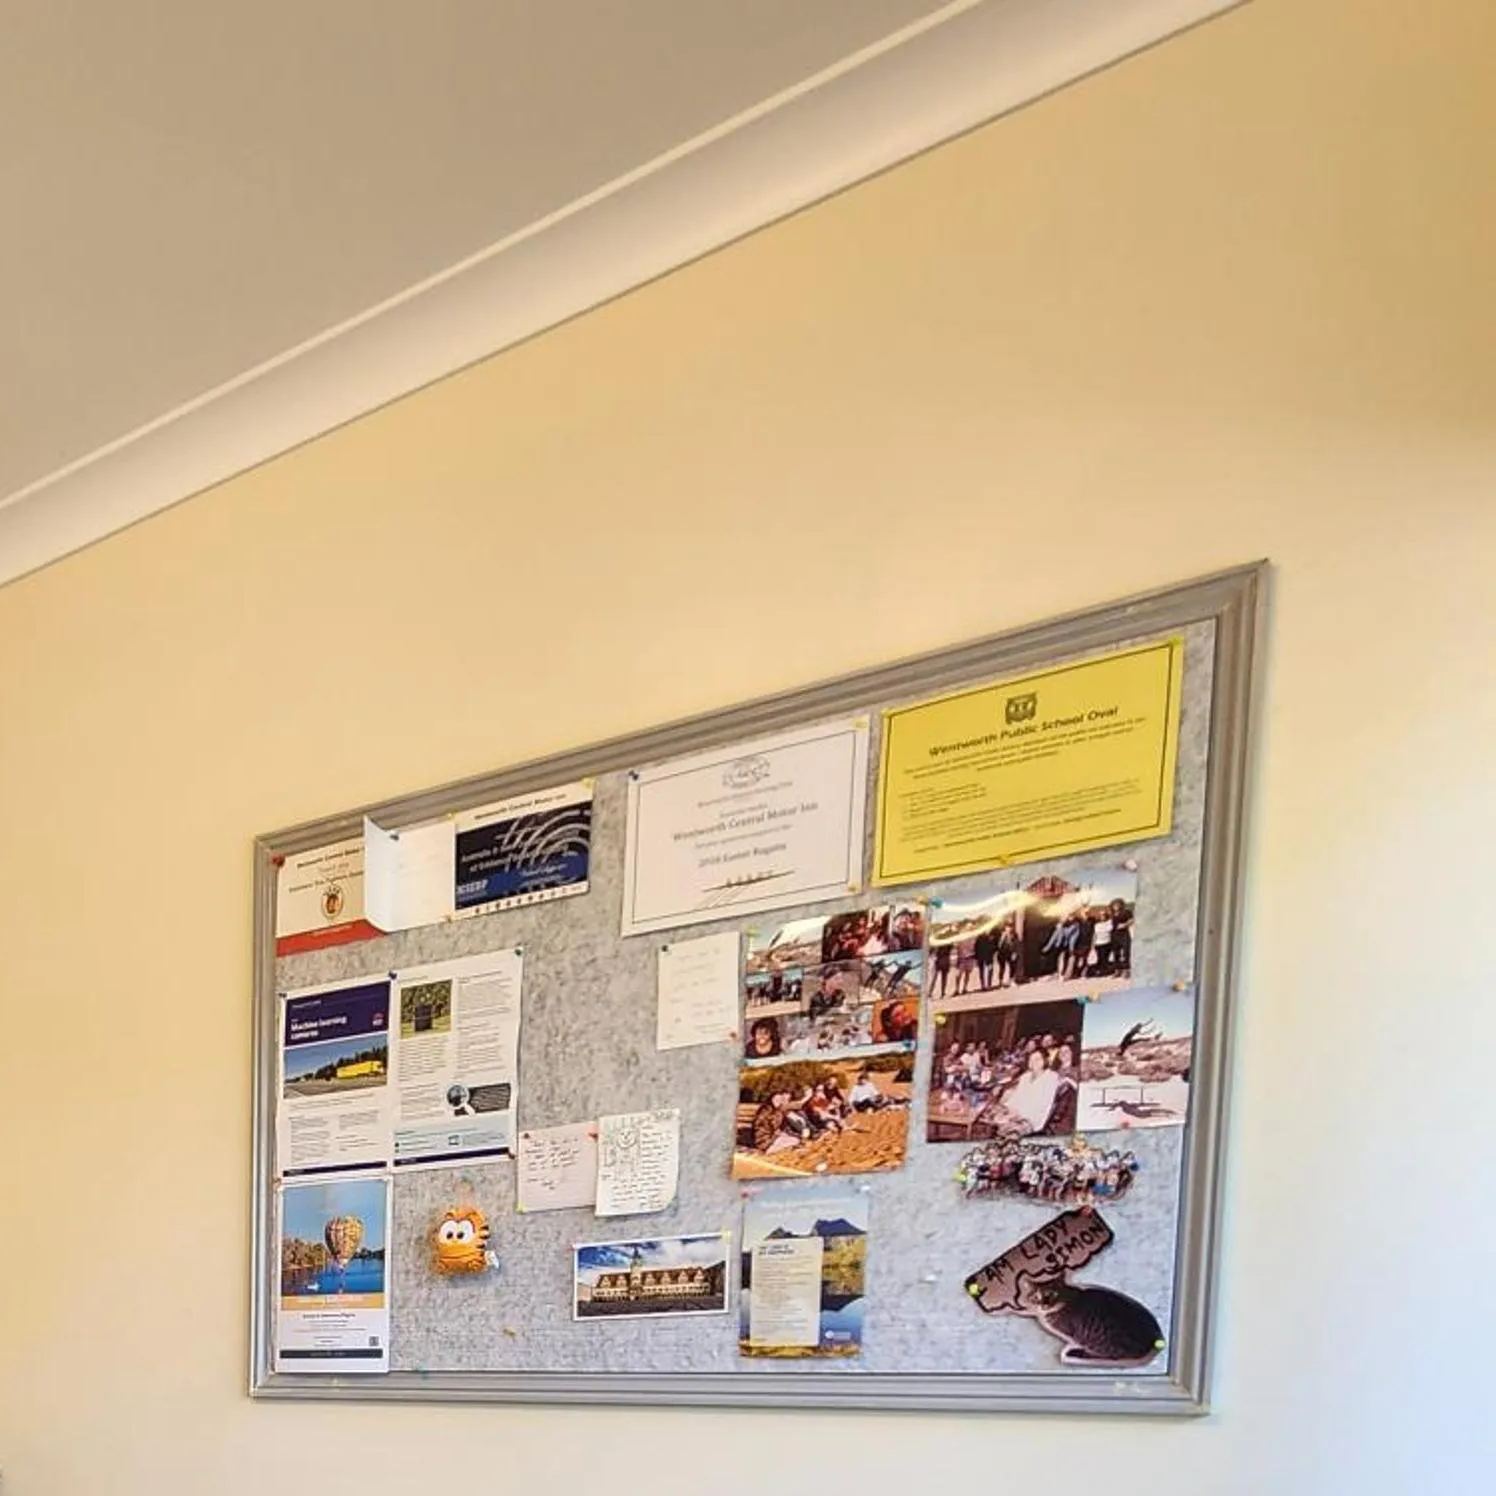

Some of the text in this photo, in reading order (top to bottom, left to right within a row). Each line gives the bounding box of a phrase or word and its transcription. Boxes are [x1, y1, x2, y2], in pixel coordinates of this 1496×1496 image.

[929, 706, 1119, 757] Wentworth Public School Oval
[985, 1219, 1068, 1285] AM LADY
[1045, 1221, 1104, 1272] SIMON
